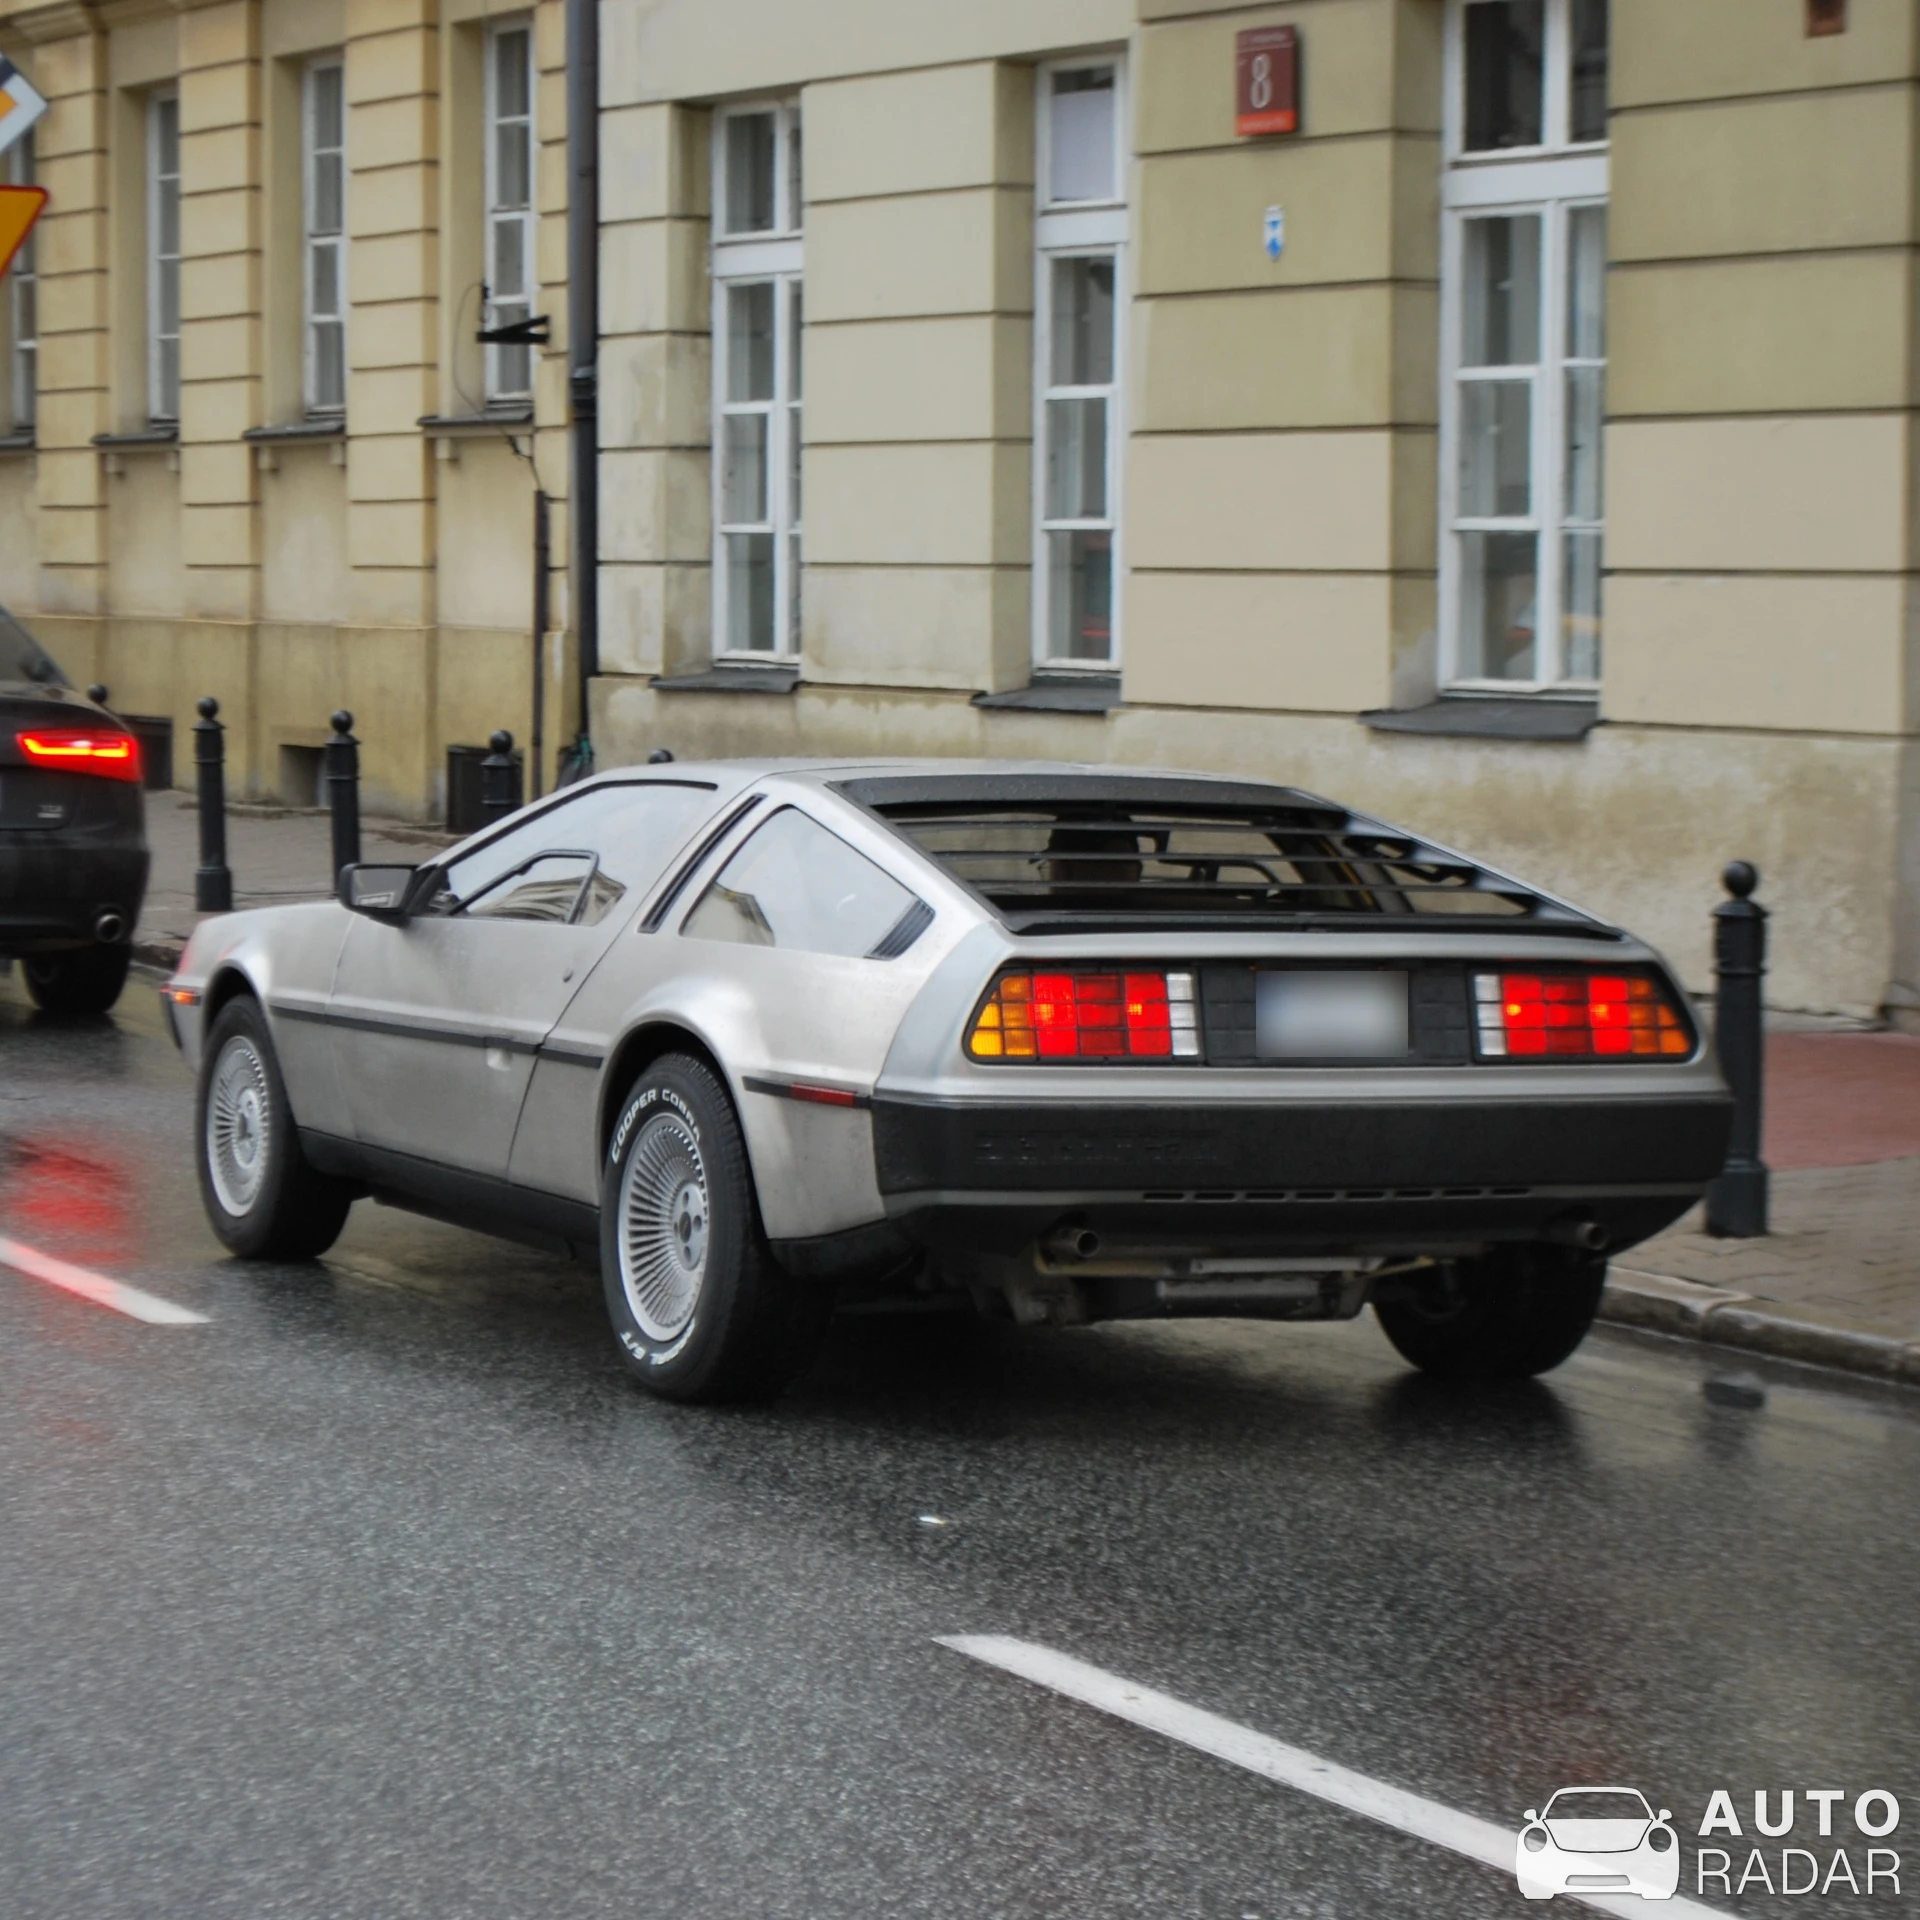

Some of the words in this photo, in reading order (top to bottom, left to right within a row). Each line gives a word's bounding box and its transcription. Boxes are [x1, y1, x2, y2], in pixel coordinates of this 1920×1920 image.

[1250, 53, 1271, 109] 8
[611, 1088, 656, 1164] COOPER
[661, 1088, 700, 1143] COBRA
